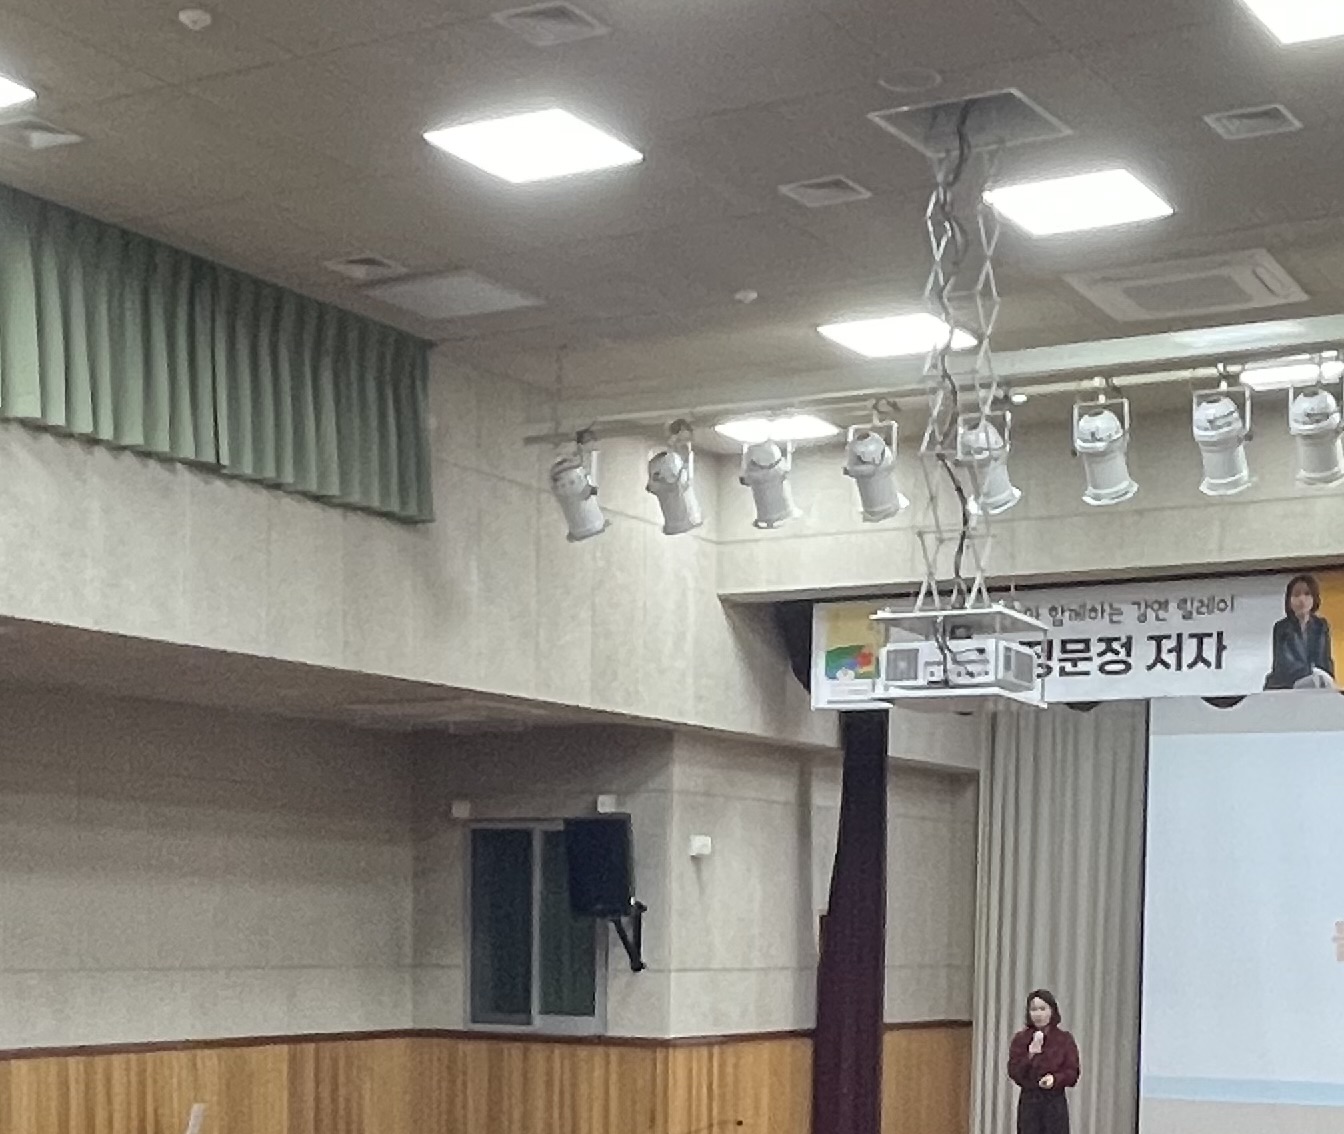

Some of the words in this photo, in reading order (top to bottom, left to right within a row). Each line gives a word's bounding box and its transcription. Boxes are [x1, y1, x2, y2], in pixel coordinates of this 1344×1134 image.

[1048, 601, 1124, 628] 함께하는
[1131, 598, 1170, 624] 강연
[1176, 594, 1235, 621] 릴레이
[1146, 630, 1228, 672] 저자
